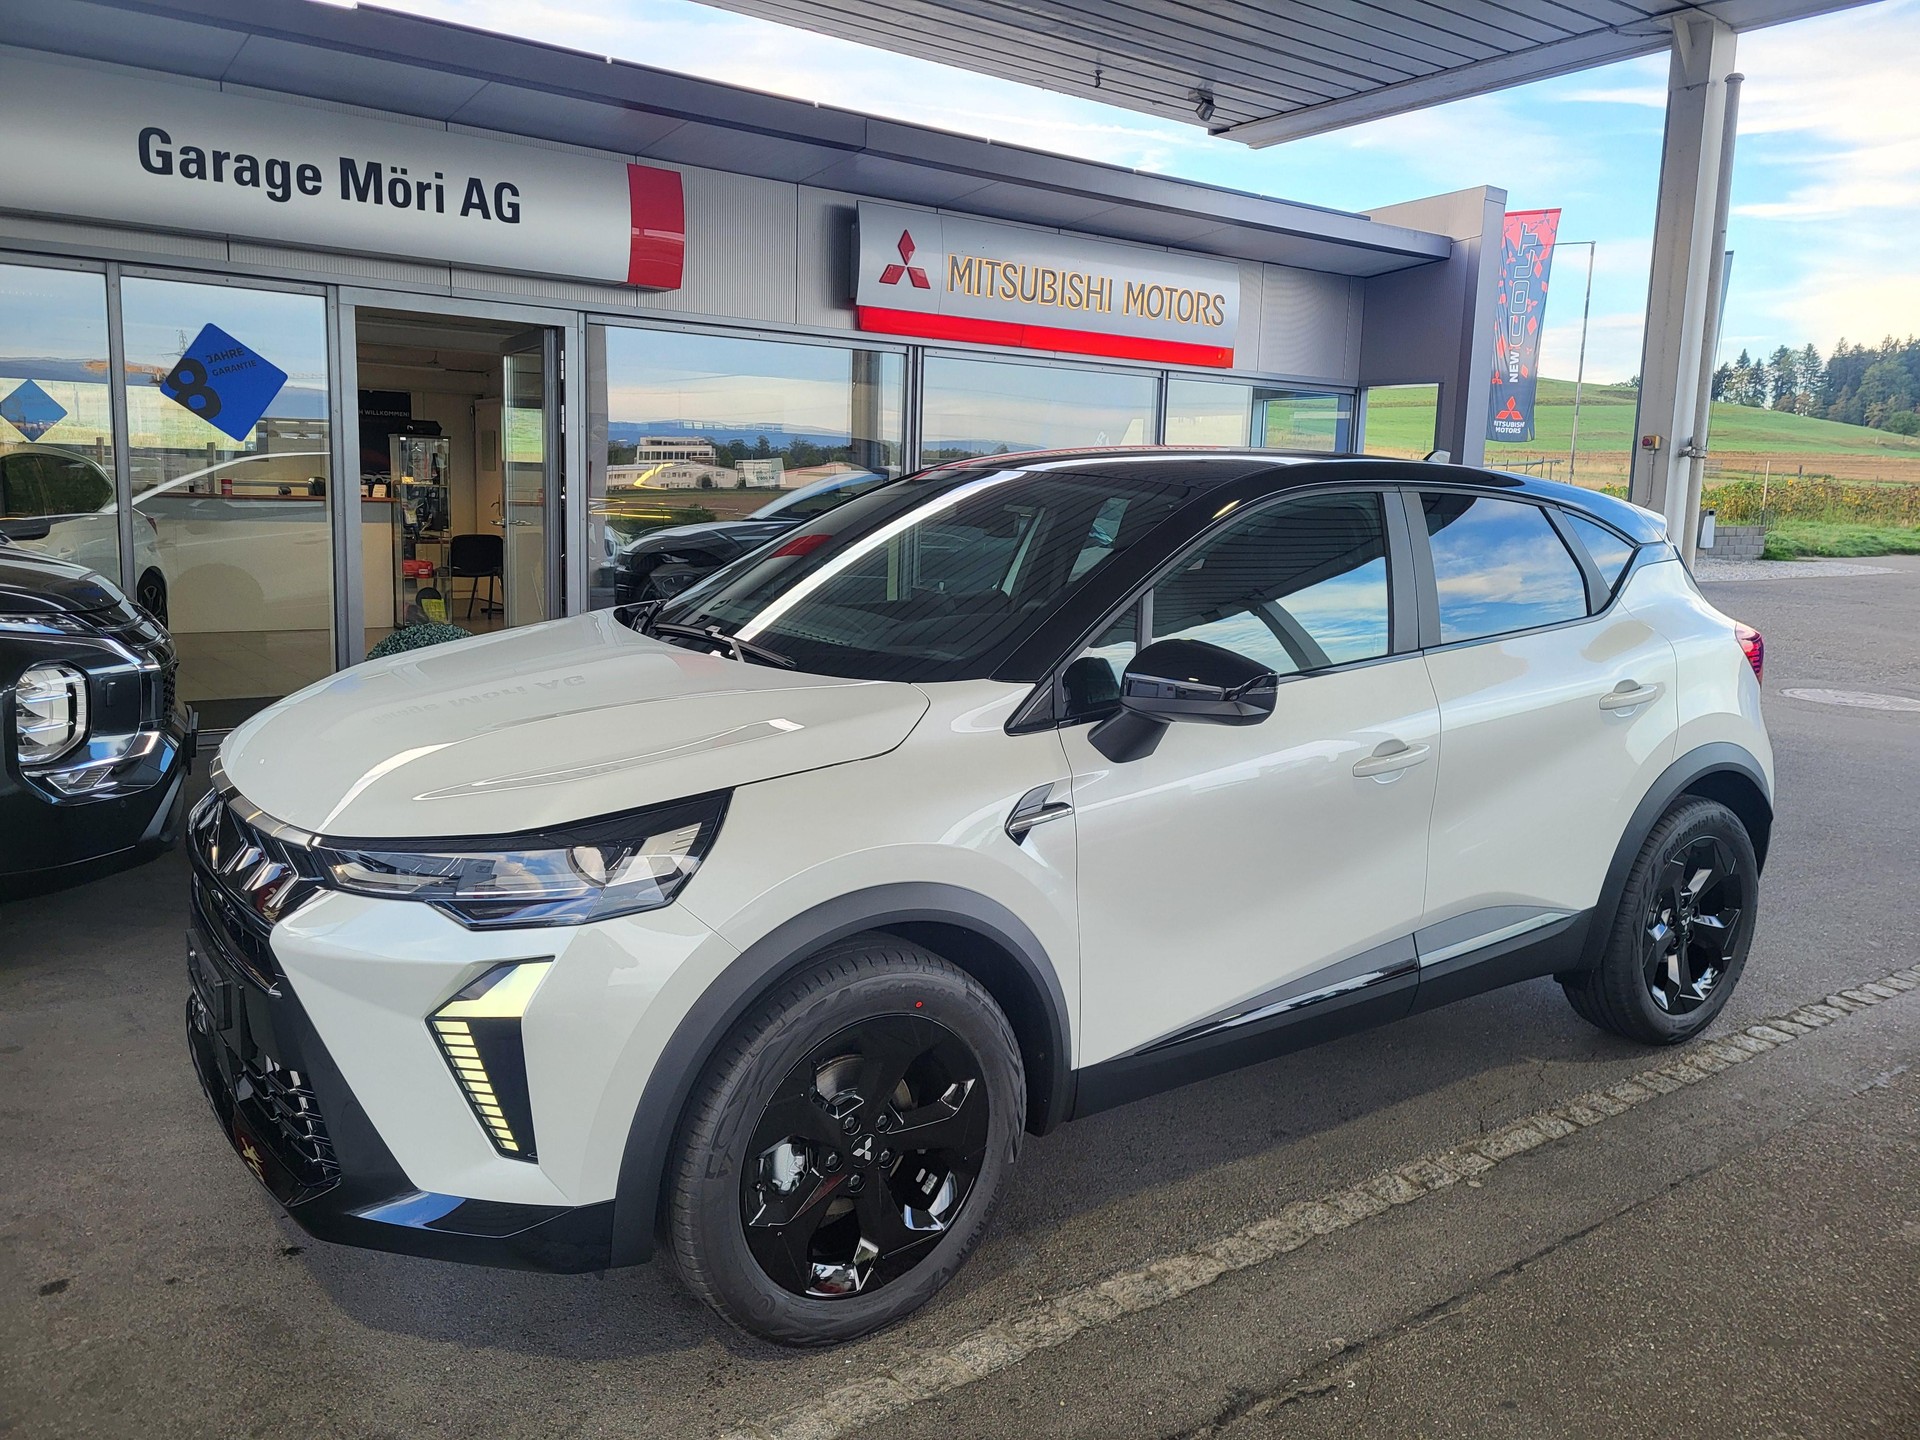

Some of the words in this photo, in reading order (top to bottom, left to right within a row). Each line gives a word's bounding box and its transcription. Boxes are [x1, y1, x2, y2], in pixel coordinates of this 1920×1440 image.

[138, 127, 322, 202] Garage
[340, 157, 444, 213] Möri
[460, 177, 521, 224] AG
[948, 254, 1113, 313] MITSUBISHI
[1123, 281, 1226, 327] MOTORS
[1508, 222, 1538, 347] COLT
[206, 347, 244, 364] JAHRE
[212, 360, 257, 377] GARANTIE
[1509, 350, 1519, 383] NEW
[166, 358, 221, 420] 8
